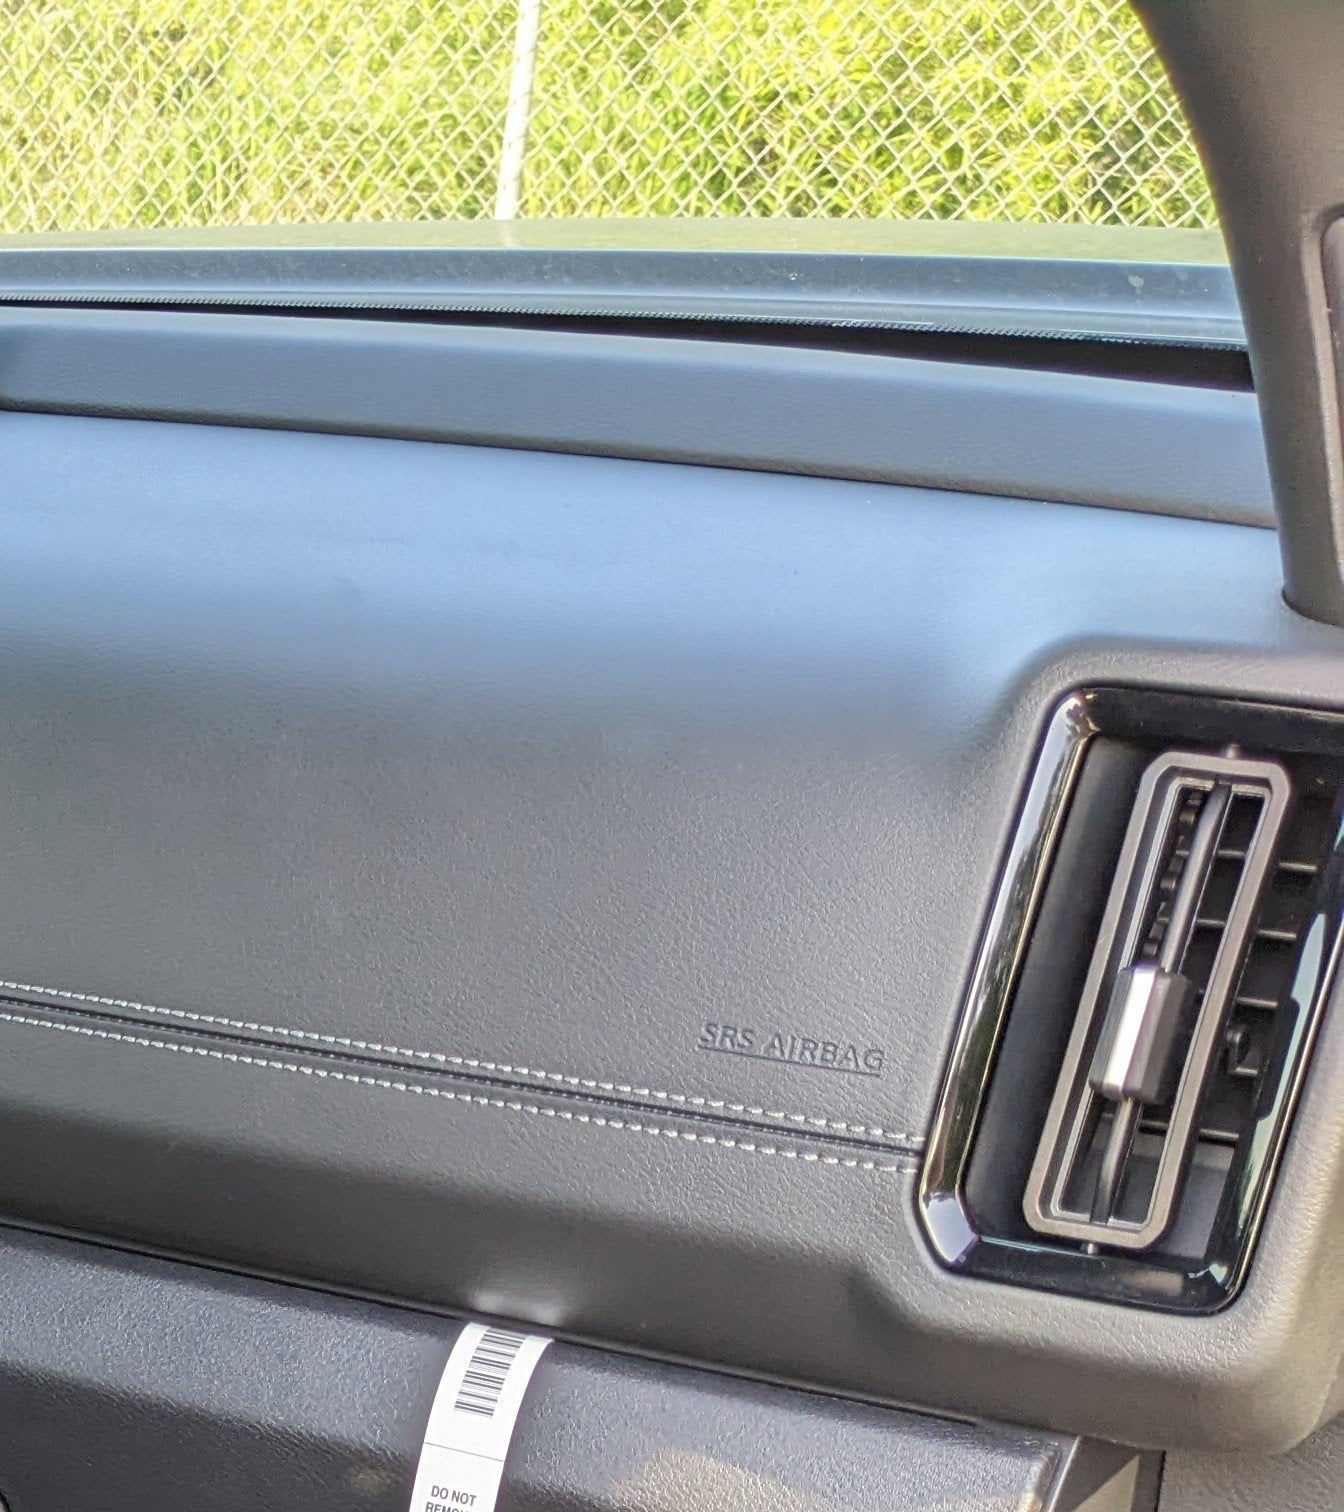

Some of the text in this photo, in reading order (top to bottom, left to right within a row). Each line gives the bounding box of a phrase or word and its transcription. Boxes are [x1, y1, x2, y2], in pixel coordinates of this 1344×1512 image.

[698, 1023, 885, 1071] SRS AIRBAG
[431, 1485, 477, 1506] DO NOT
